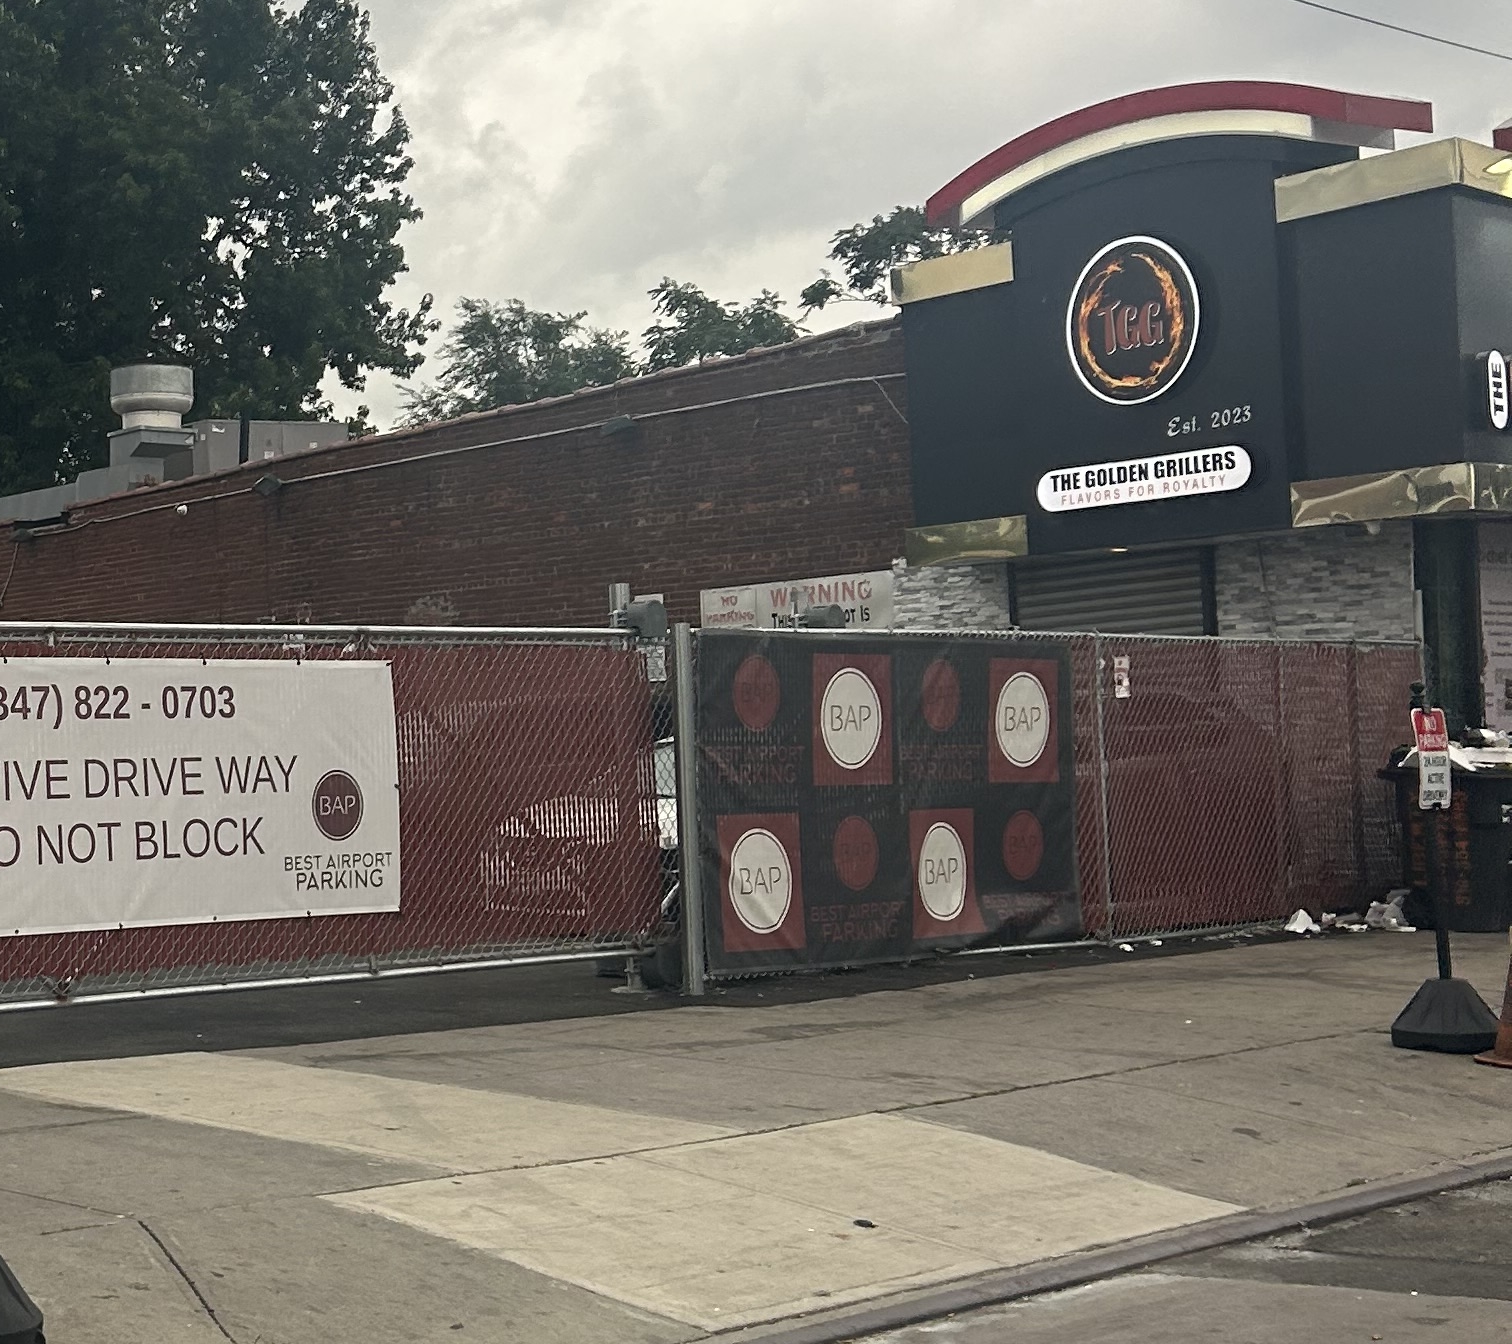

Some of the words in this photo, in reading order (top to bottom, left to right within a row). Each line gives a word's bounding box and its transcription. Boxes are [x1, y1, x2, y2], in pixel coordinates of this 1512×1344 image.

[1097, 299, 1164, 355] TGG
[1491, 362, 1504, 416] THE
[1167, 415, 1201, 437] Est.
[1211, 405, 1251, 429] 2023
[1050, 471, 1081, 493] THE
[1084, 462, 1149, 489] GOLDEN
[1153, 450, 1236, 479] GRILLERS
[1060, 487, 1121, 506] FLAVORS
[1128, 483, 1155, 498] FOR
[1162, 473, 1227, 493] ROYALTY
[73, 685, 131, 720] 822
[162, 684, 236, 720] 0703
[830, 704, 872, 732] BAP
[1004, 706, 1042, 732] BAP
[84, 756, 205, 800] DRIVE
[214, 754, 298, 795] WAY
[319, 795, 356, 816] BAP
[36, 821, 122, 865] NOT
[134, 816, 266, 860] BLOCK
[284, 854, 323, 872] BEST
[326, 851, 393, 869] AIRPORT
[924, 857, 958, 885] BAP
[296, 868, 384, 891] PARKING
[739, 866, 782, 895] BAP
[810, 905, 846, 922] BEST
